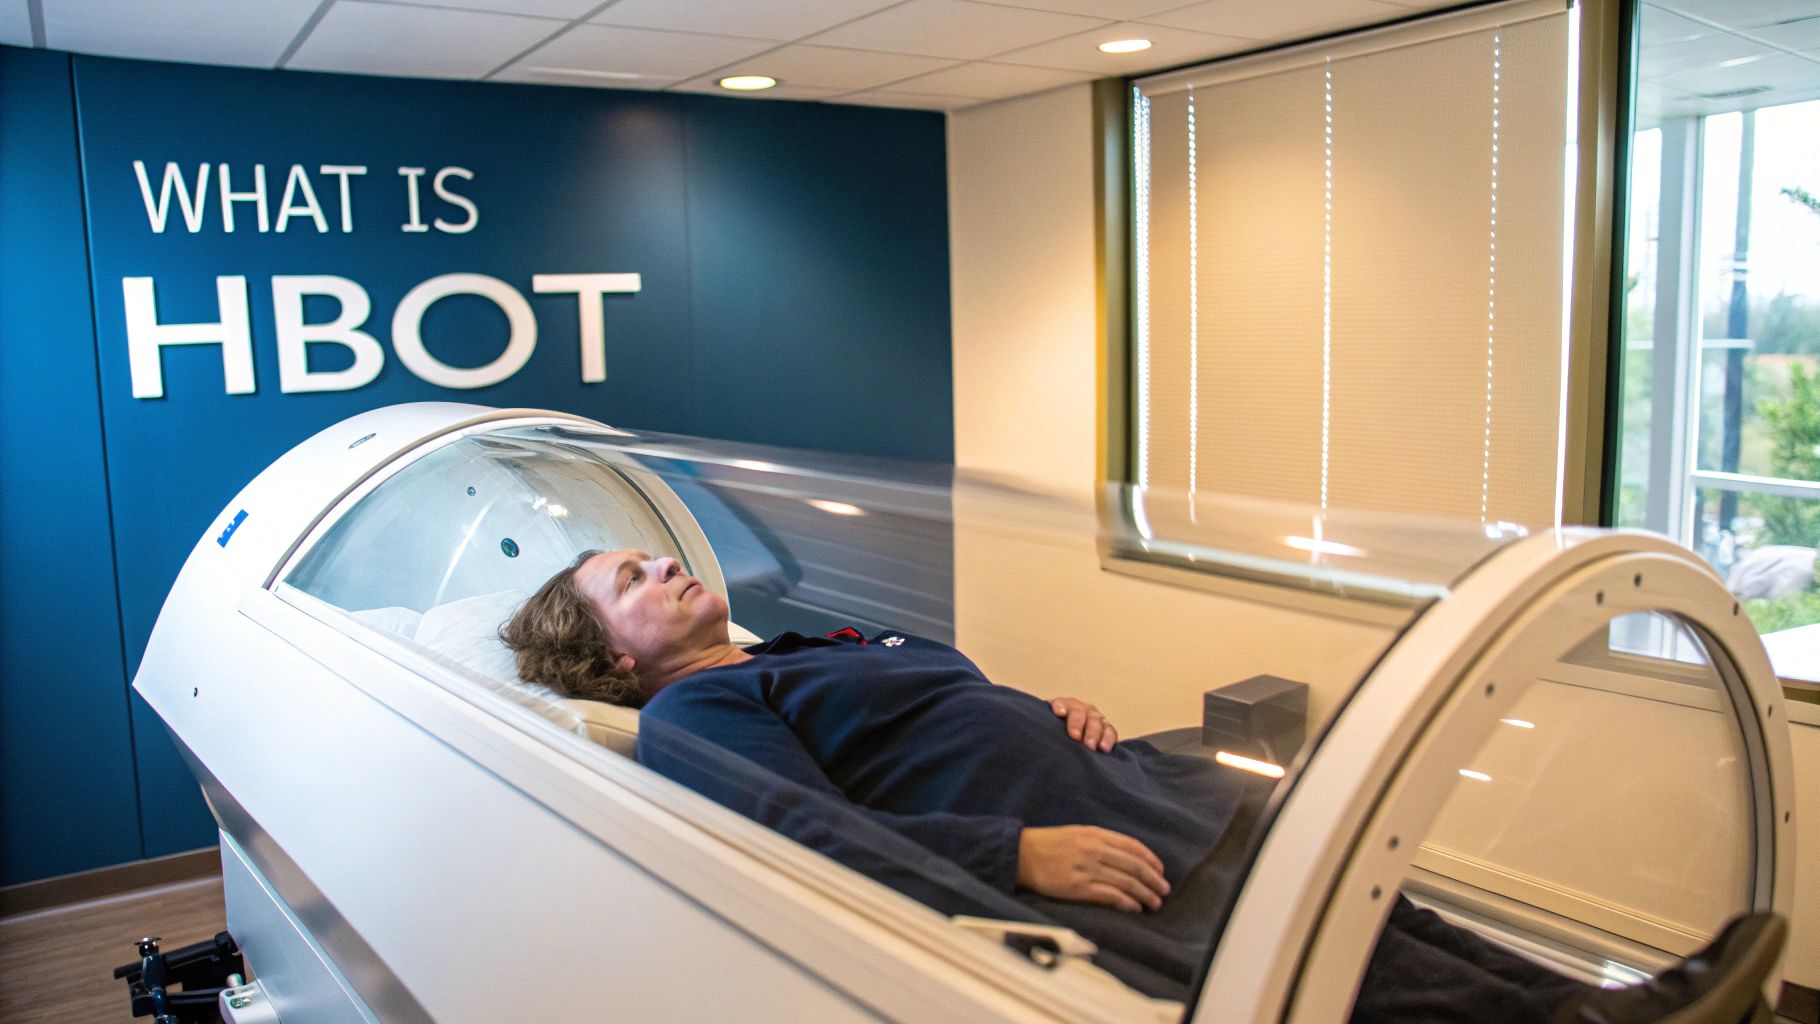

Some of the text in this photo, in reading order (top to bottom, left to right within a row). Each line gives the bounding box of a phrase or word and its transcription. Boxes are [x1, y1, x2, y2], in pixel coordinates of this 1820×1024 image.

[134, 161, 478, 233] WHAT IS
[123, 273, 641, 398] HBOT
